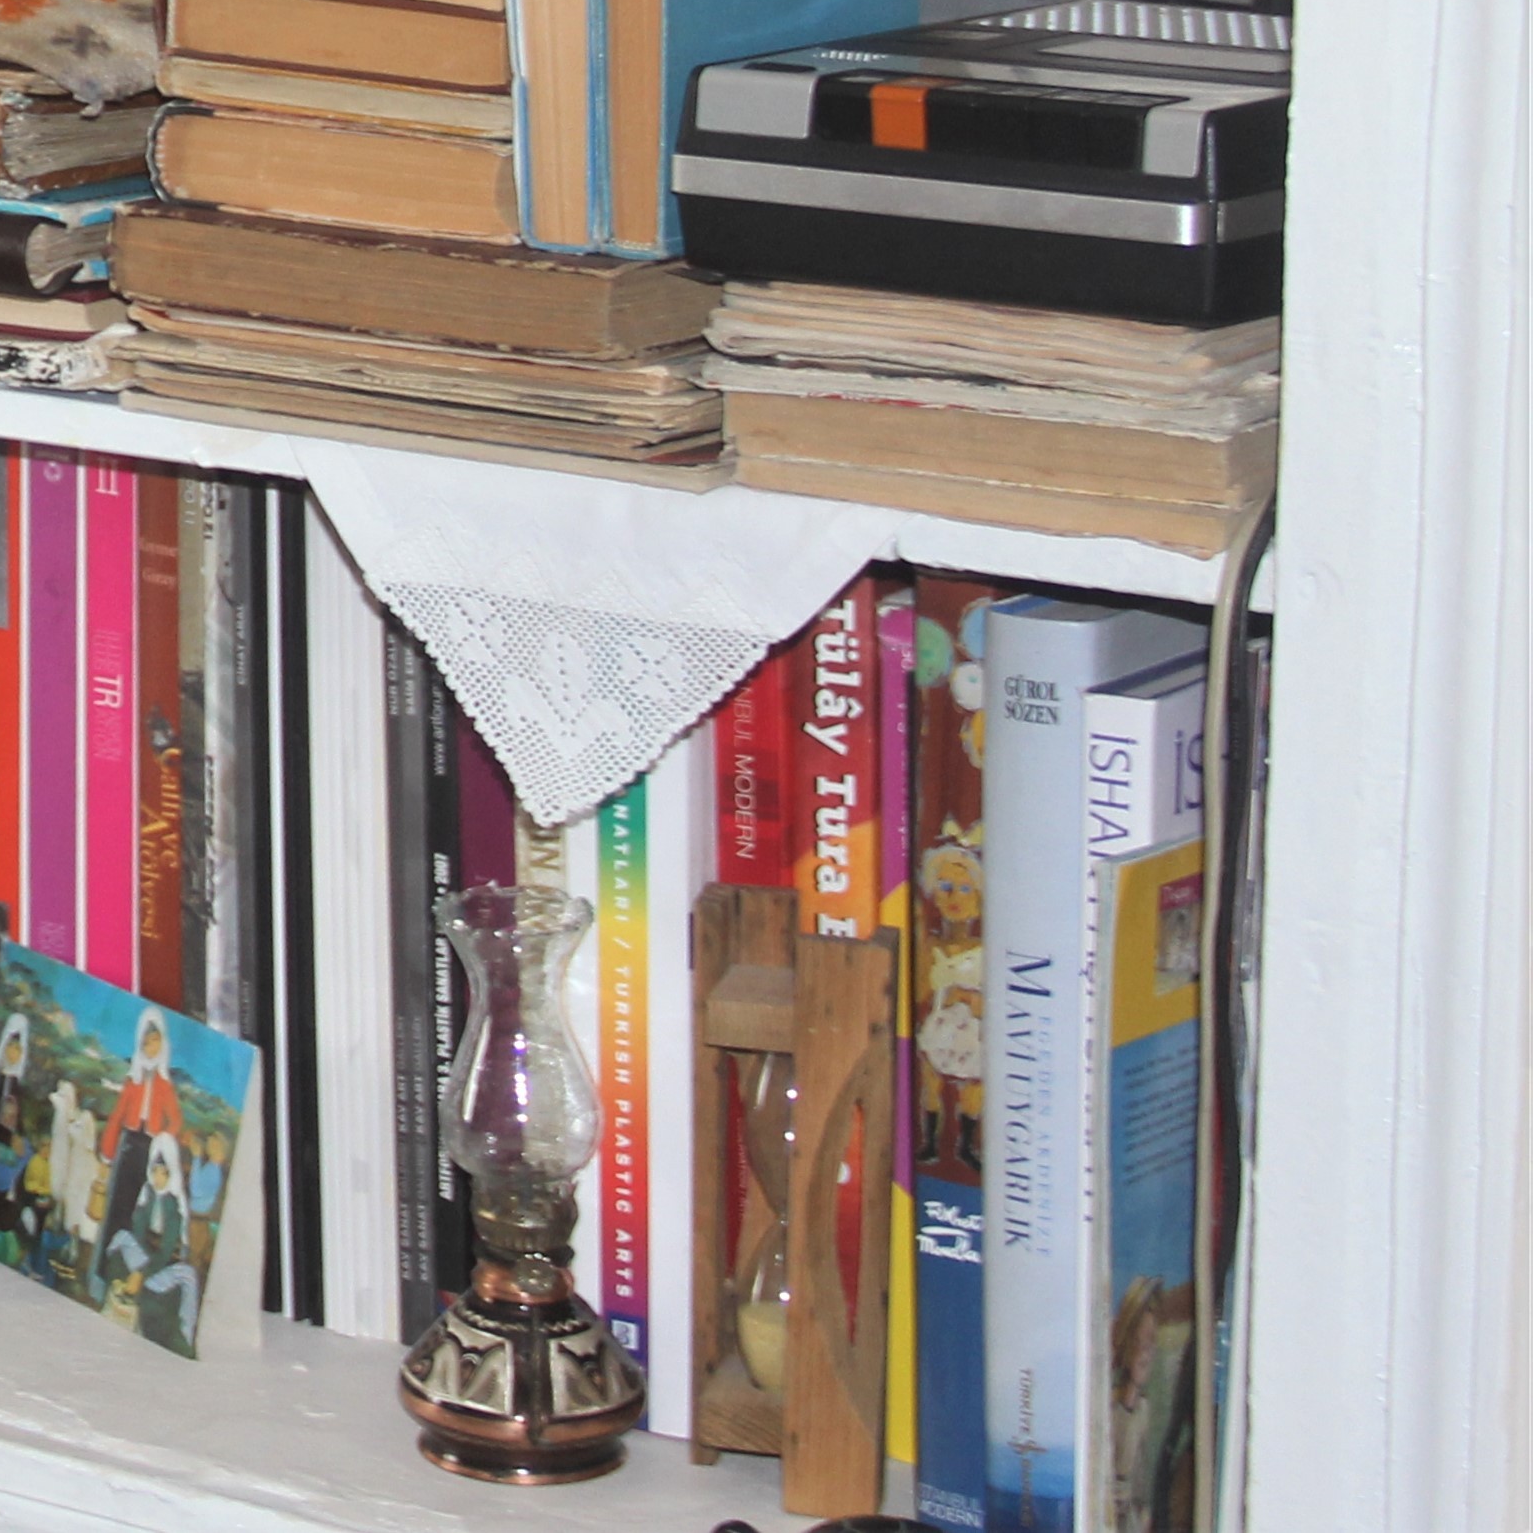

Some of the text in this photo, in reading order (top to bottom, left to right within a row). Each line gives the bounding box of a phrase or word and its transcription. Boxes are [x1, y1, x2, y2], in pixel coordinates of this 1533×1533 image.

[802, 599, 864, 757] Tülây
[733, 754, 756, 860] MODERN
[815, 774, 857, 894] Tura
[434, 852, 450, 885] 2007
[433, 1004, 452, 1058] PLASTİK
[613, 965, 632, 1085] TURKISH
[397, 1074, 407, 1102] ART
[414, 1074, 424, 1103] ART
[436, 1060, 452, 1074] 3.
[1003, 950, 1054, 1253] MAVİ UYGARLIK
[613, 1098, 632, 1213] PLASTIC
[400, 1203, 411, 1247] SANAT
[417, 1203, 429, 1251] SANAT
[614, 1228, 632, 1298] ARTS
